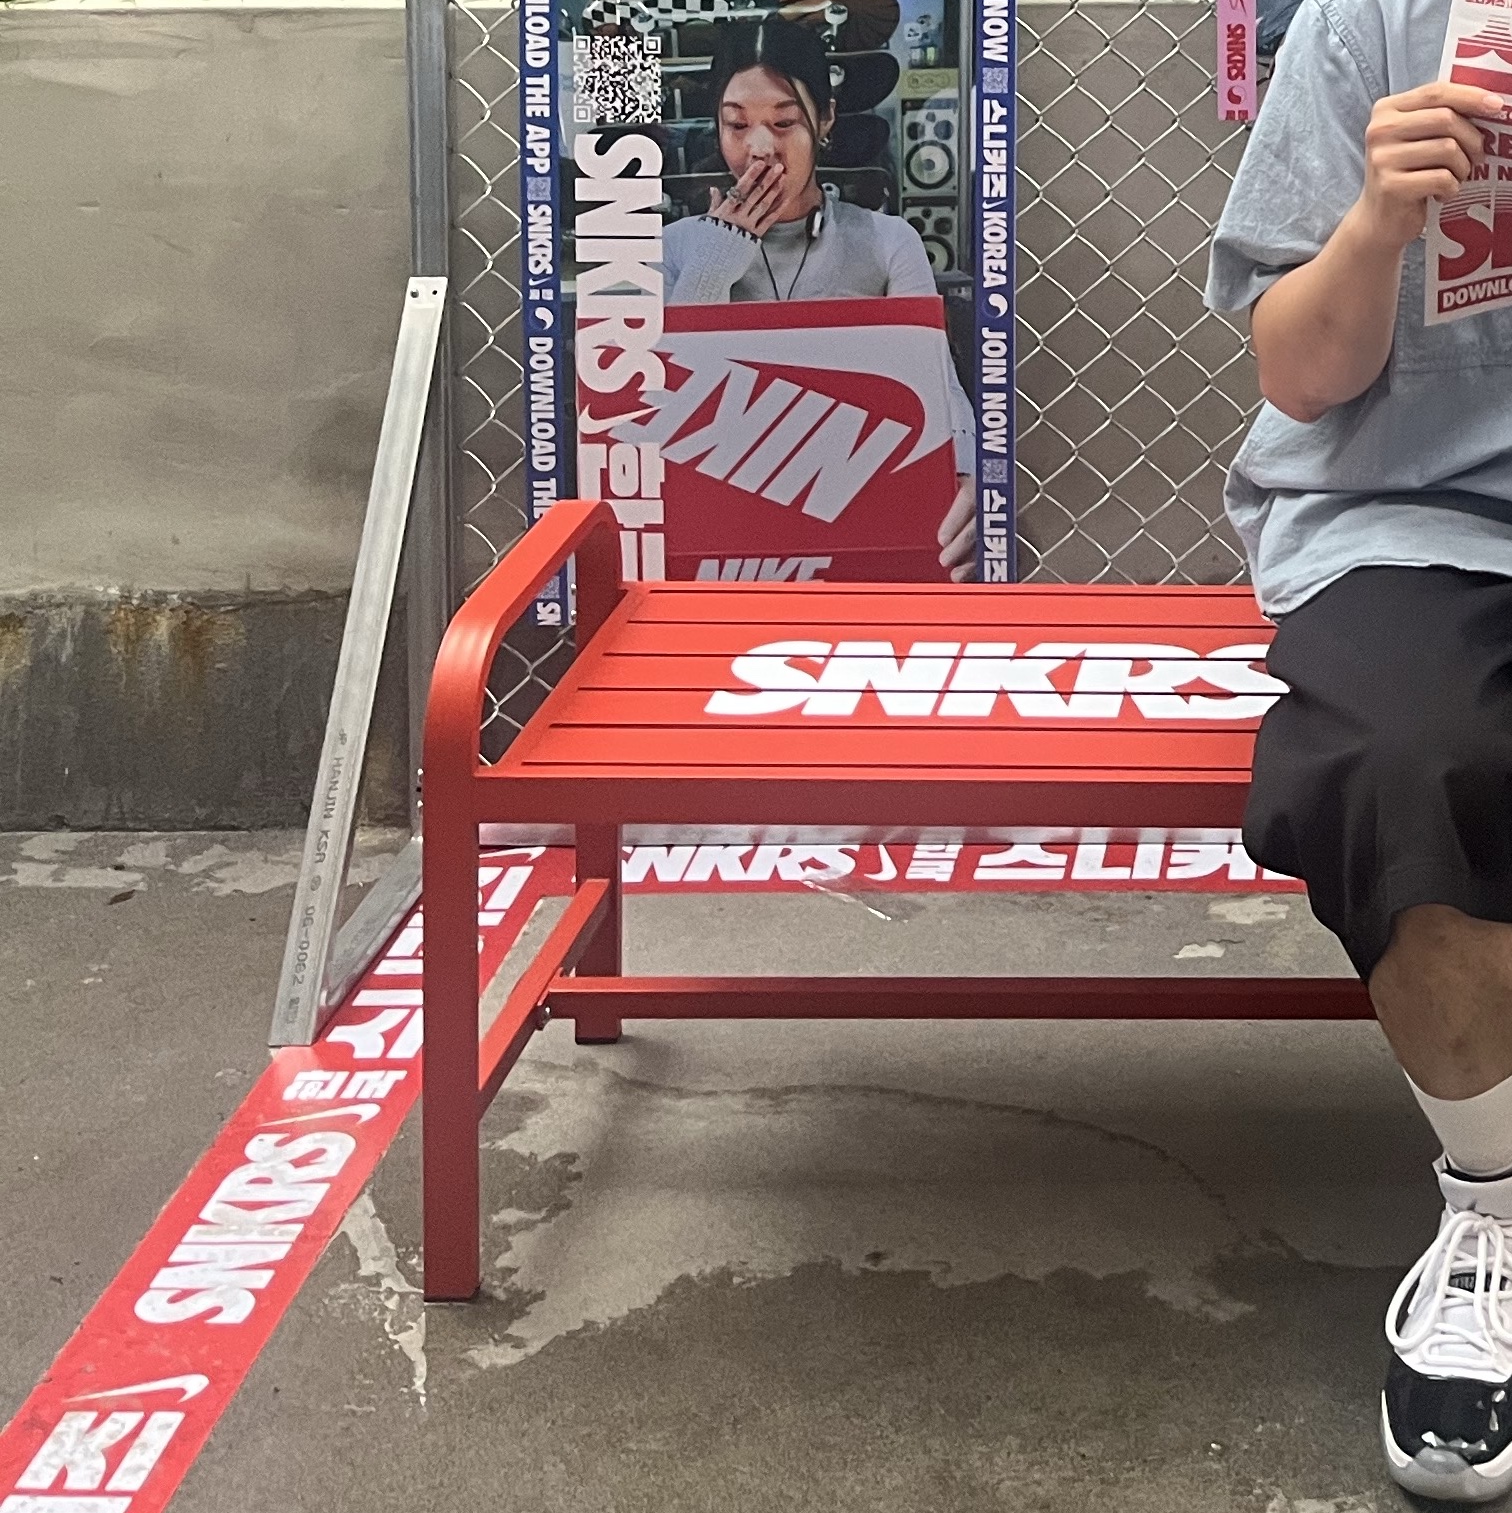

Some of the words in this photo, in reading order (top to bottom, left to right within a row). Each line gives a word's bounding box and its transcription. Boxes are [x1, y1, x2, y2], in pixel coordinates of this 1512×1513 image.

[1226, 23, 1247, 82] SNKRS
[525, 73, 551, 118] THE
[525, 123, 551, 175] APP
[982, 98, 1008, 199] 스니커즈
[527, 203, 554, 276] SNKRS
[574, 132, 666, 394] SNKRS
[982, 210, 1008, 289] KOREA
[981, 326, 1008, 384] JOIN
[529, 336, 556, 472] DOWNLOAD
[608, 354, 912, 523] NIKE
[981, 392, 1008, 455] NOW
[703, 640, 1291, 720] SNKRS
[623, 844, 859, 882] NKRS
[134, 1130, 357, 1325] SNKRS
